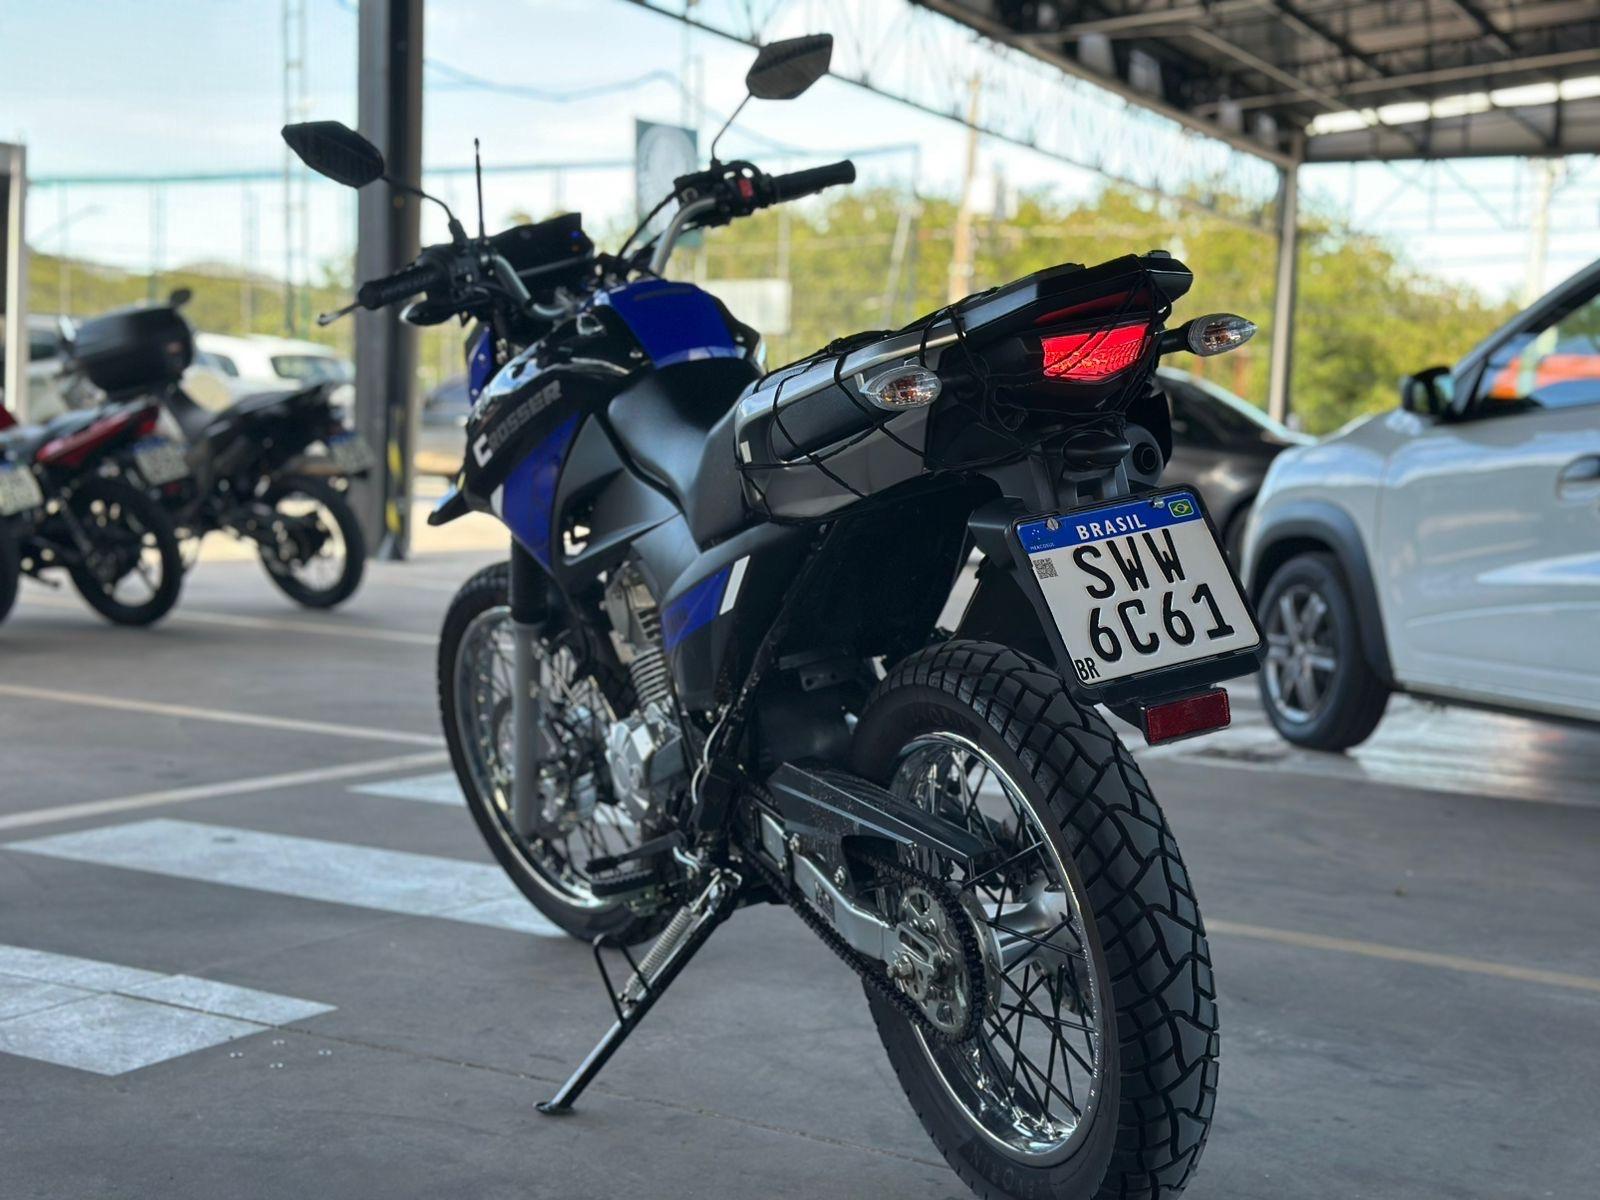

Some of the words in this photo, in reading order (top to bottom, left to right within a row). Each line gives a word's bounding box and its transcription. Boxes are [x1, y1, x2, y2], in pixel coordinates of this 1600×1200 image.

[472, 379, 562, 468] CROSSER
[1076, 514, 1147, 541] BRASIL
[1072, 528, 1186, 599] SWW
[1089, 583, 1235, 663] 6C61
[1075, 657, 1100, 681] BR
